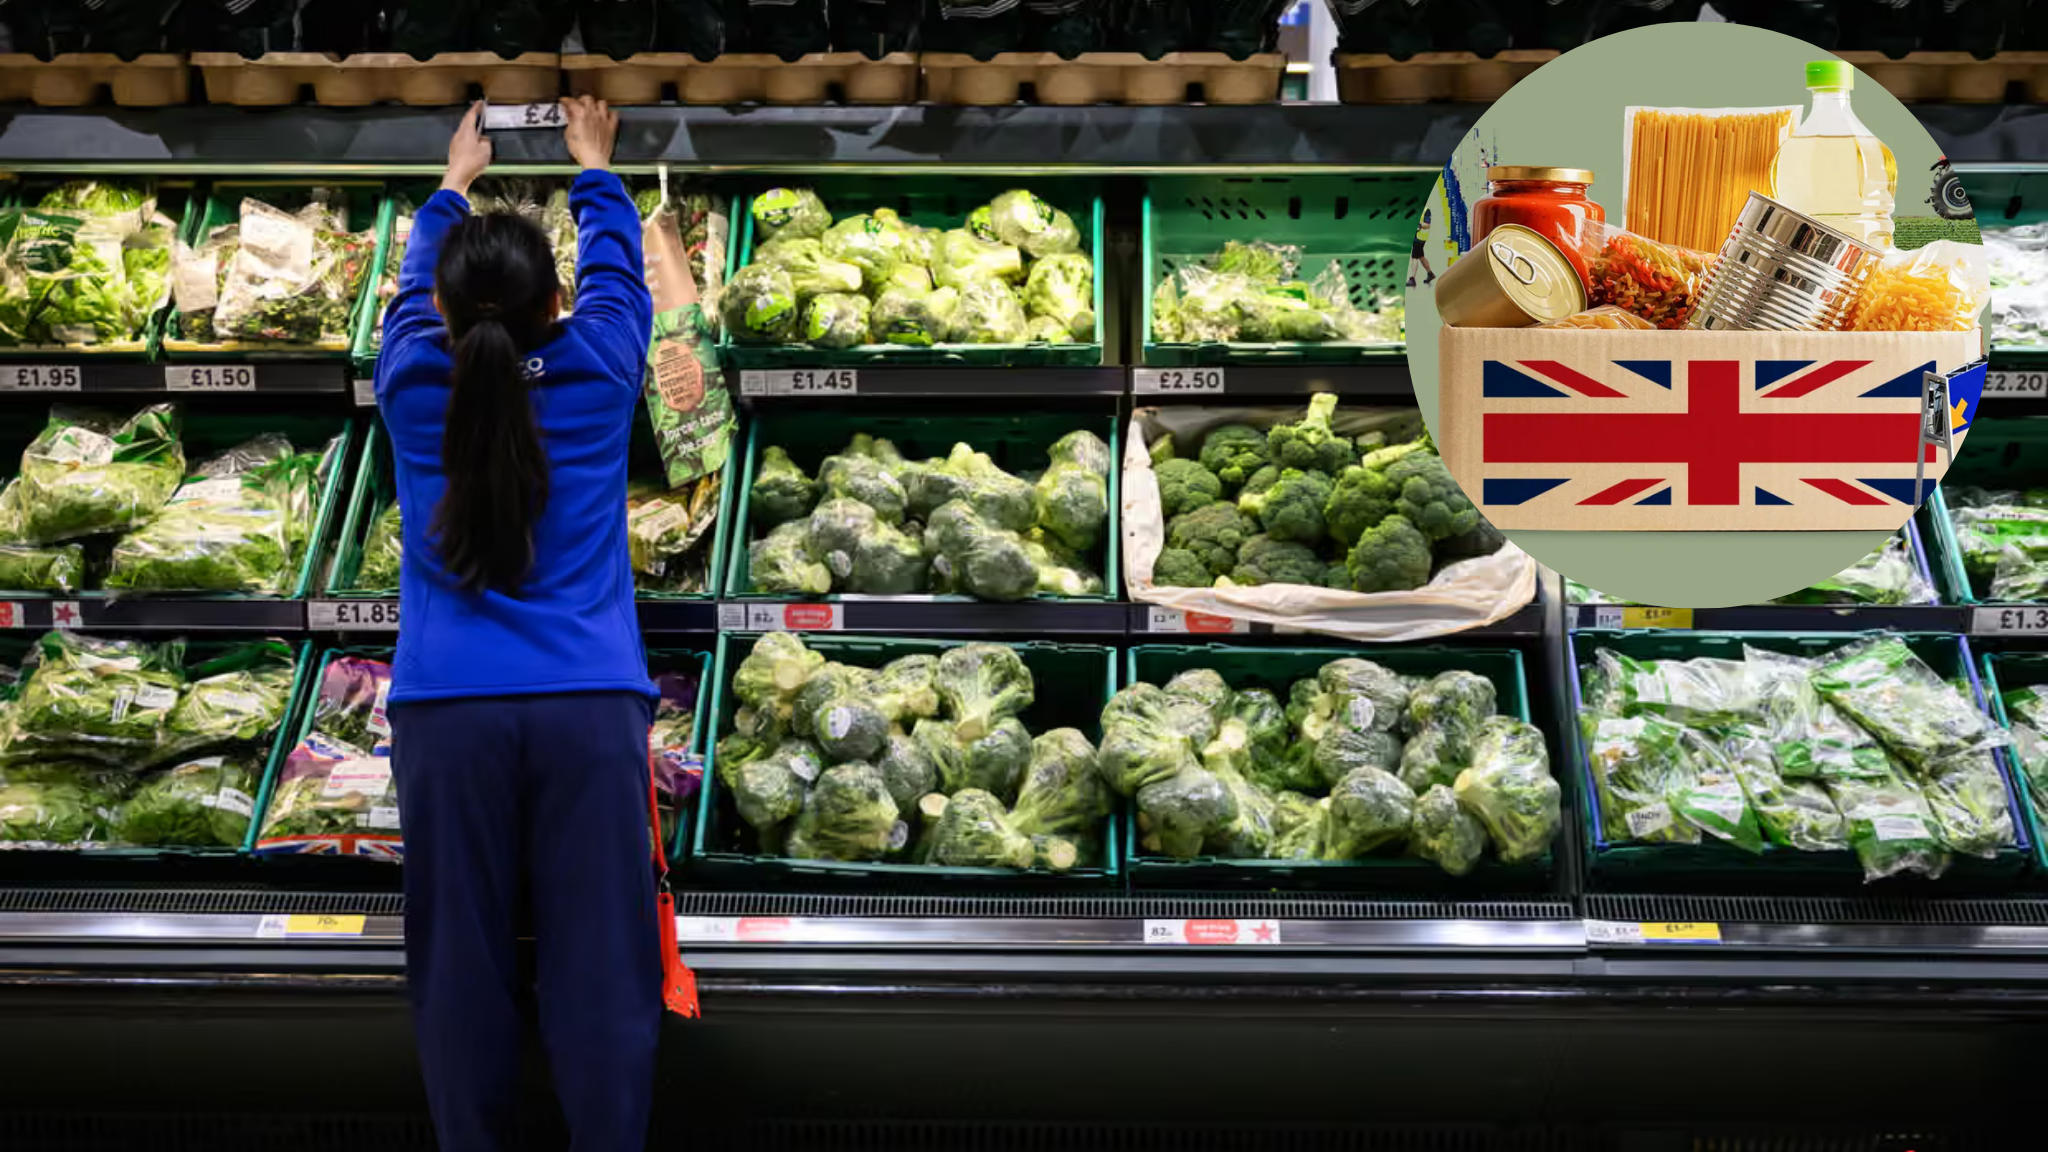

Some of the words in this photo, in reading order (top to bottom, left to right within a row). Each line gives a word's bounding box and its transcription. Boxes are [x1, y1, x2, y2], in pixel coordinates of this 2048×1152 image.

[17, 368, 77, 387] £1.95
[191, 368, 251, 387] £1.50
[792, 371, 853, 390] £1.45
[1160, 371, 1220, 389] £2.50
[1983, 374, 2042, 391] £2.20
[336, 603, 400, 623] £1.85
